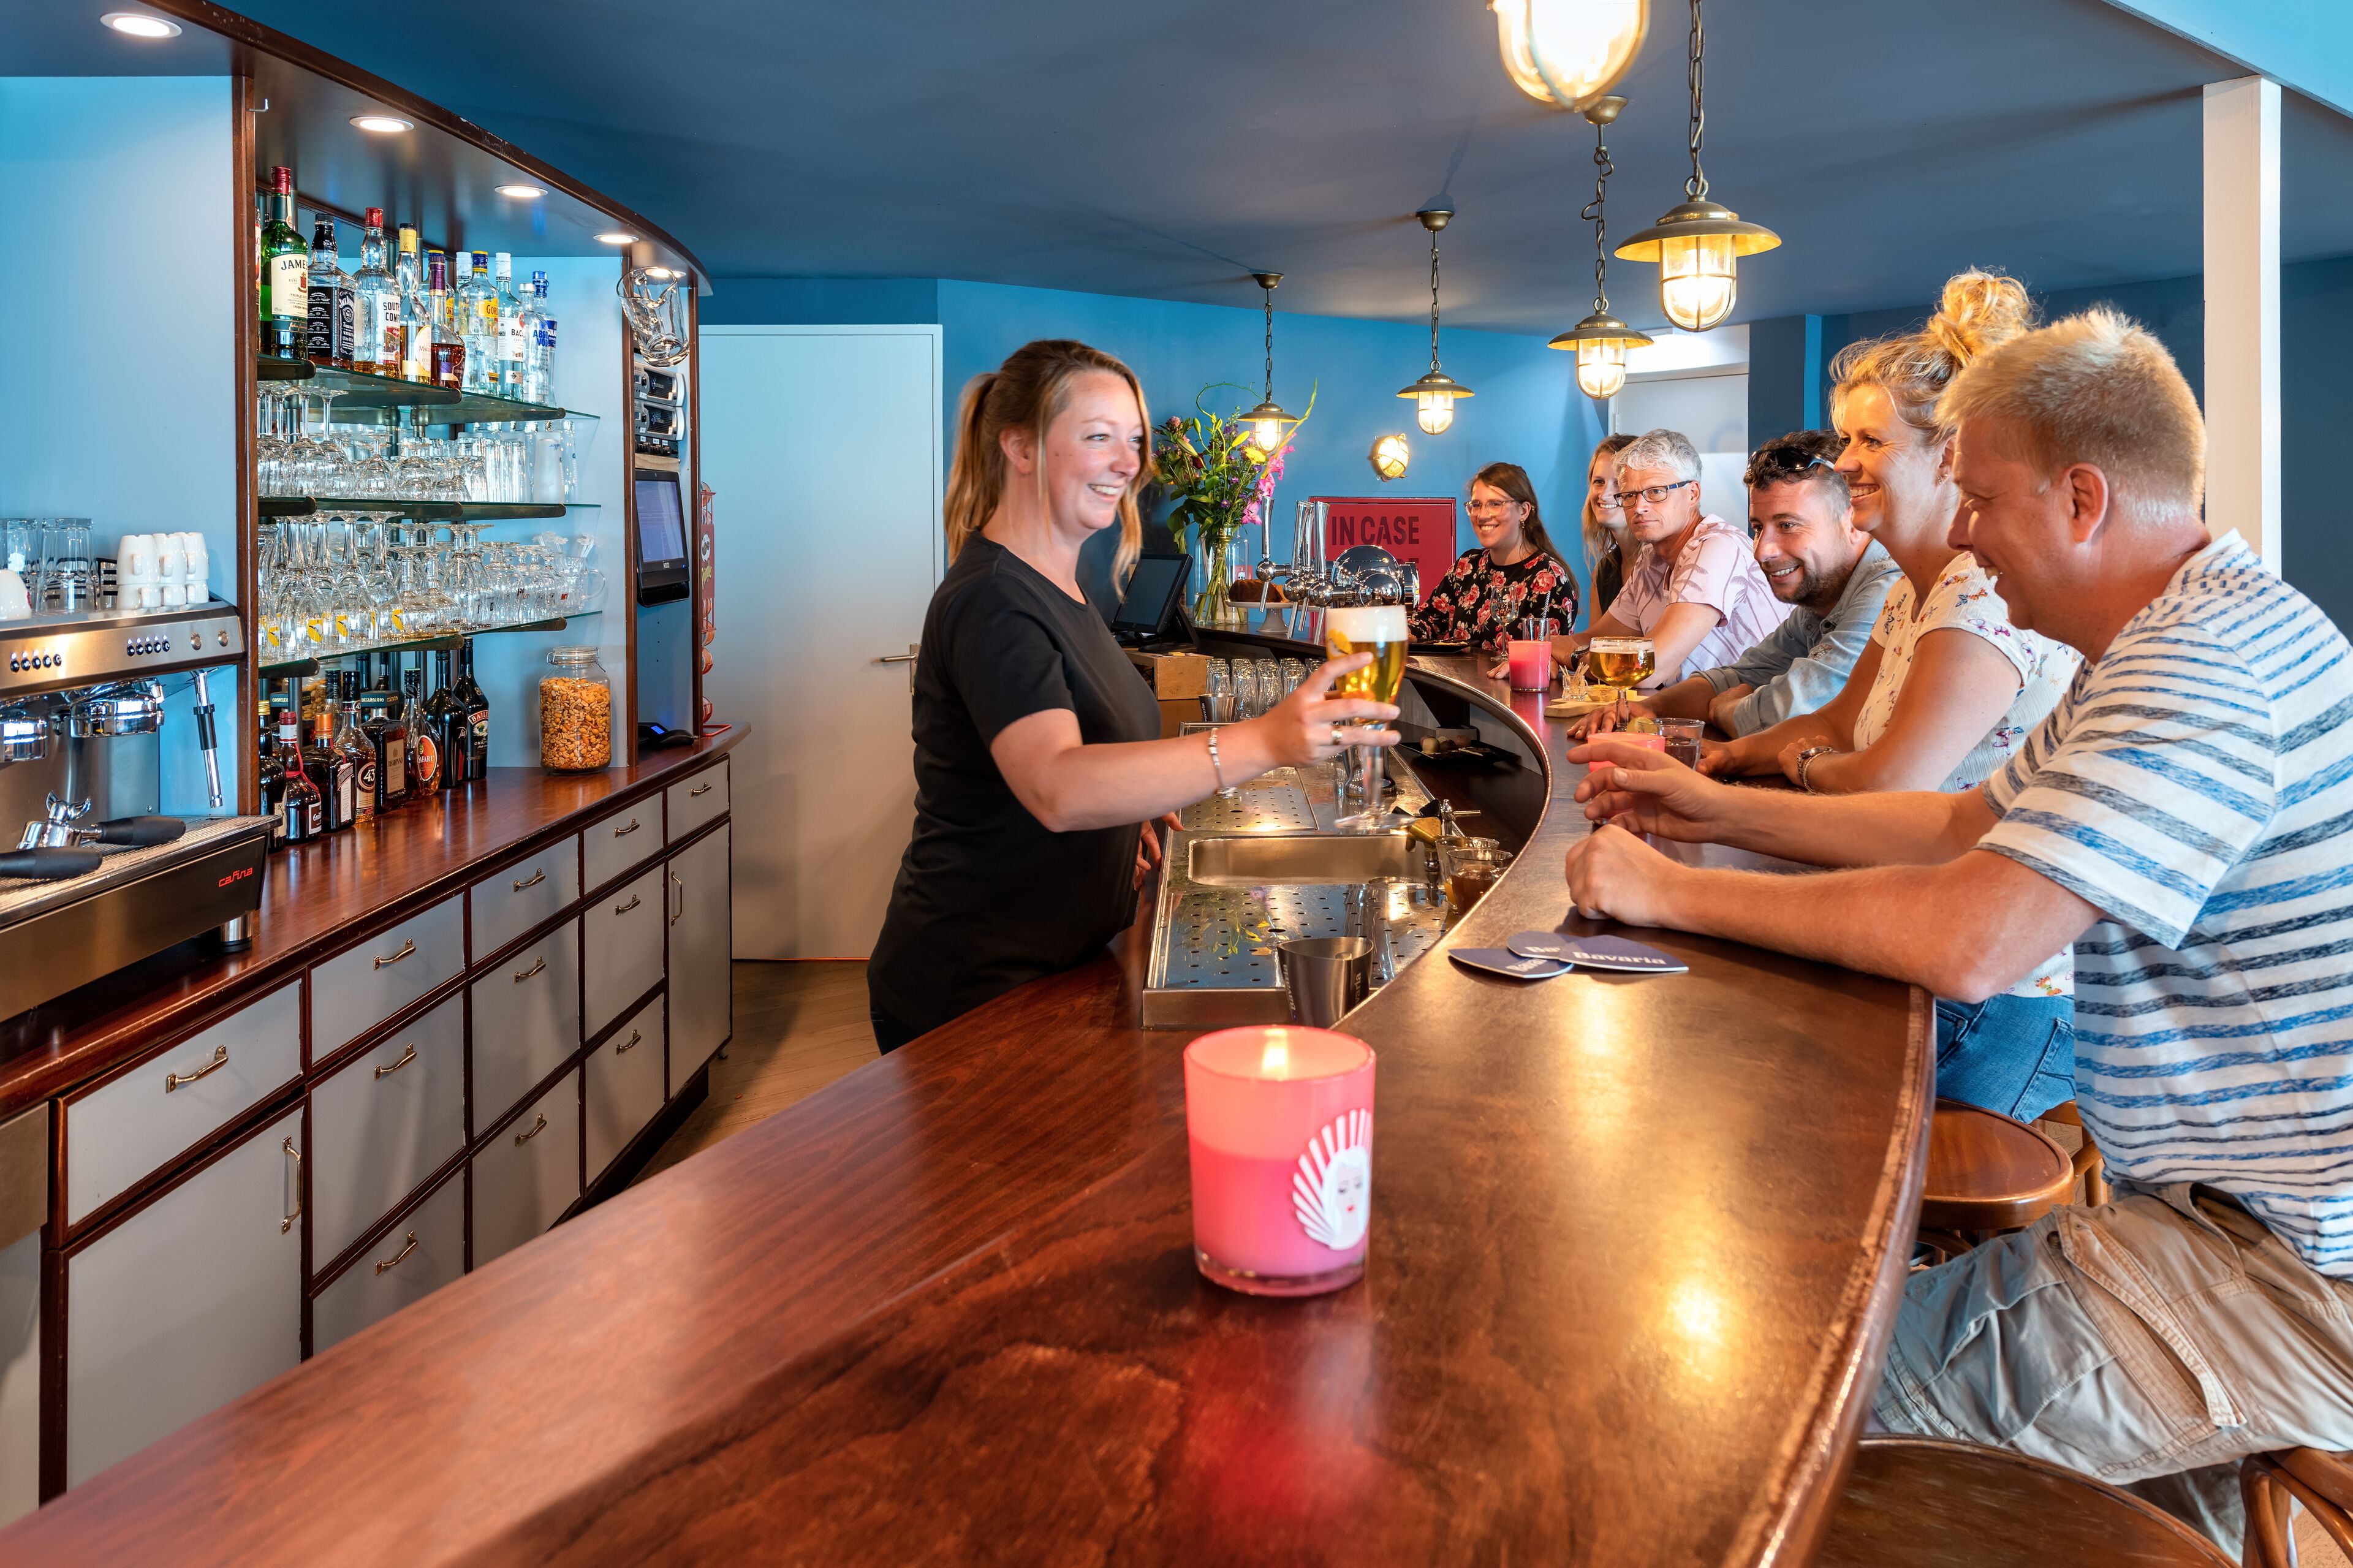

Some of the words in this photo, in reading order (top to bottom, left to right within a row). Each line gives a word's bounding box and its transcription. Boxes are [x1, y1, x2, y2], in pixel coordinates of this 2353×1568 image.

[1332, 517, 1354, 545] IN
[1360, 516, 1419, 545] CASE
[388, 757, 403, 768] DISARONNO
[418, 754, 433, 763] SAFARI
[363, 768, 376, 782] 43
[219, 867, 253, 888] cafina
[1572, 951, 1667, 965] Bavaria
[1283, 964, 1296, 1010] Bavaria
